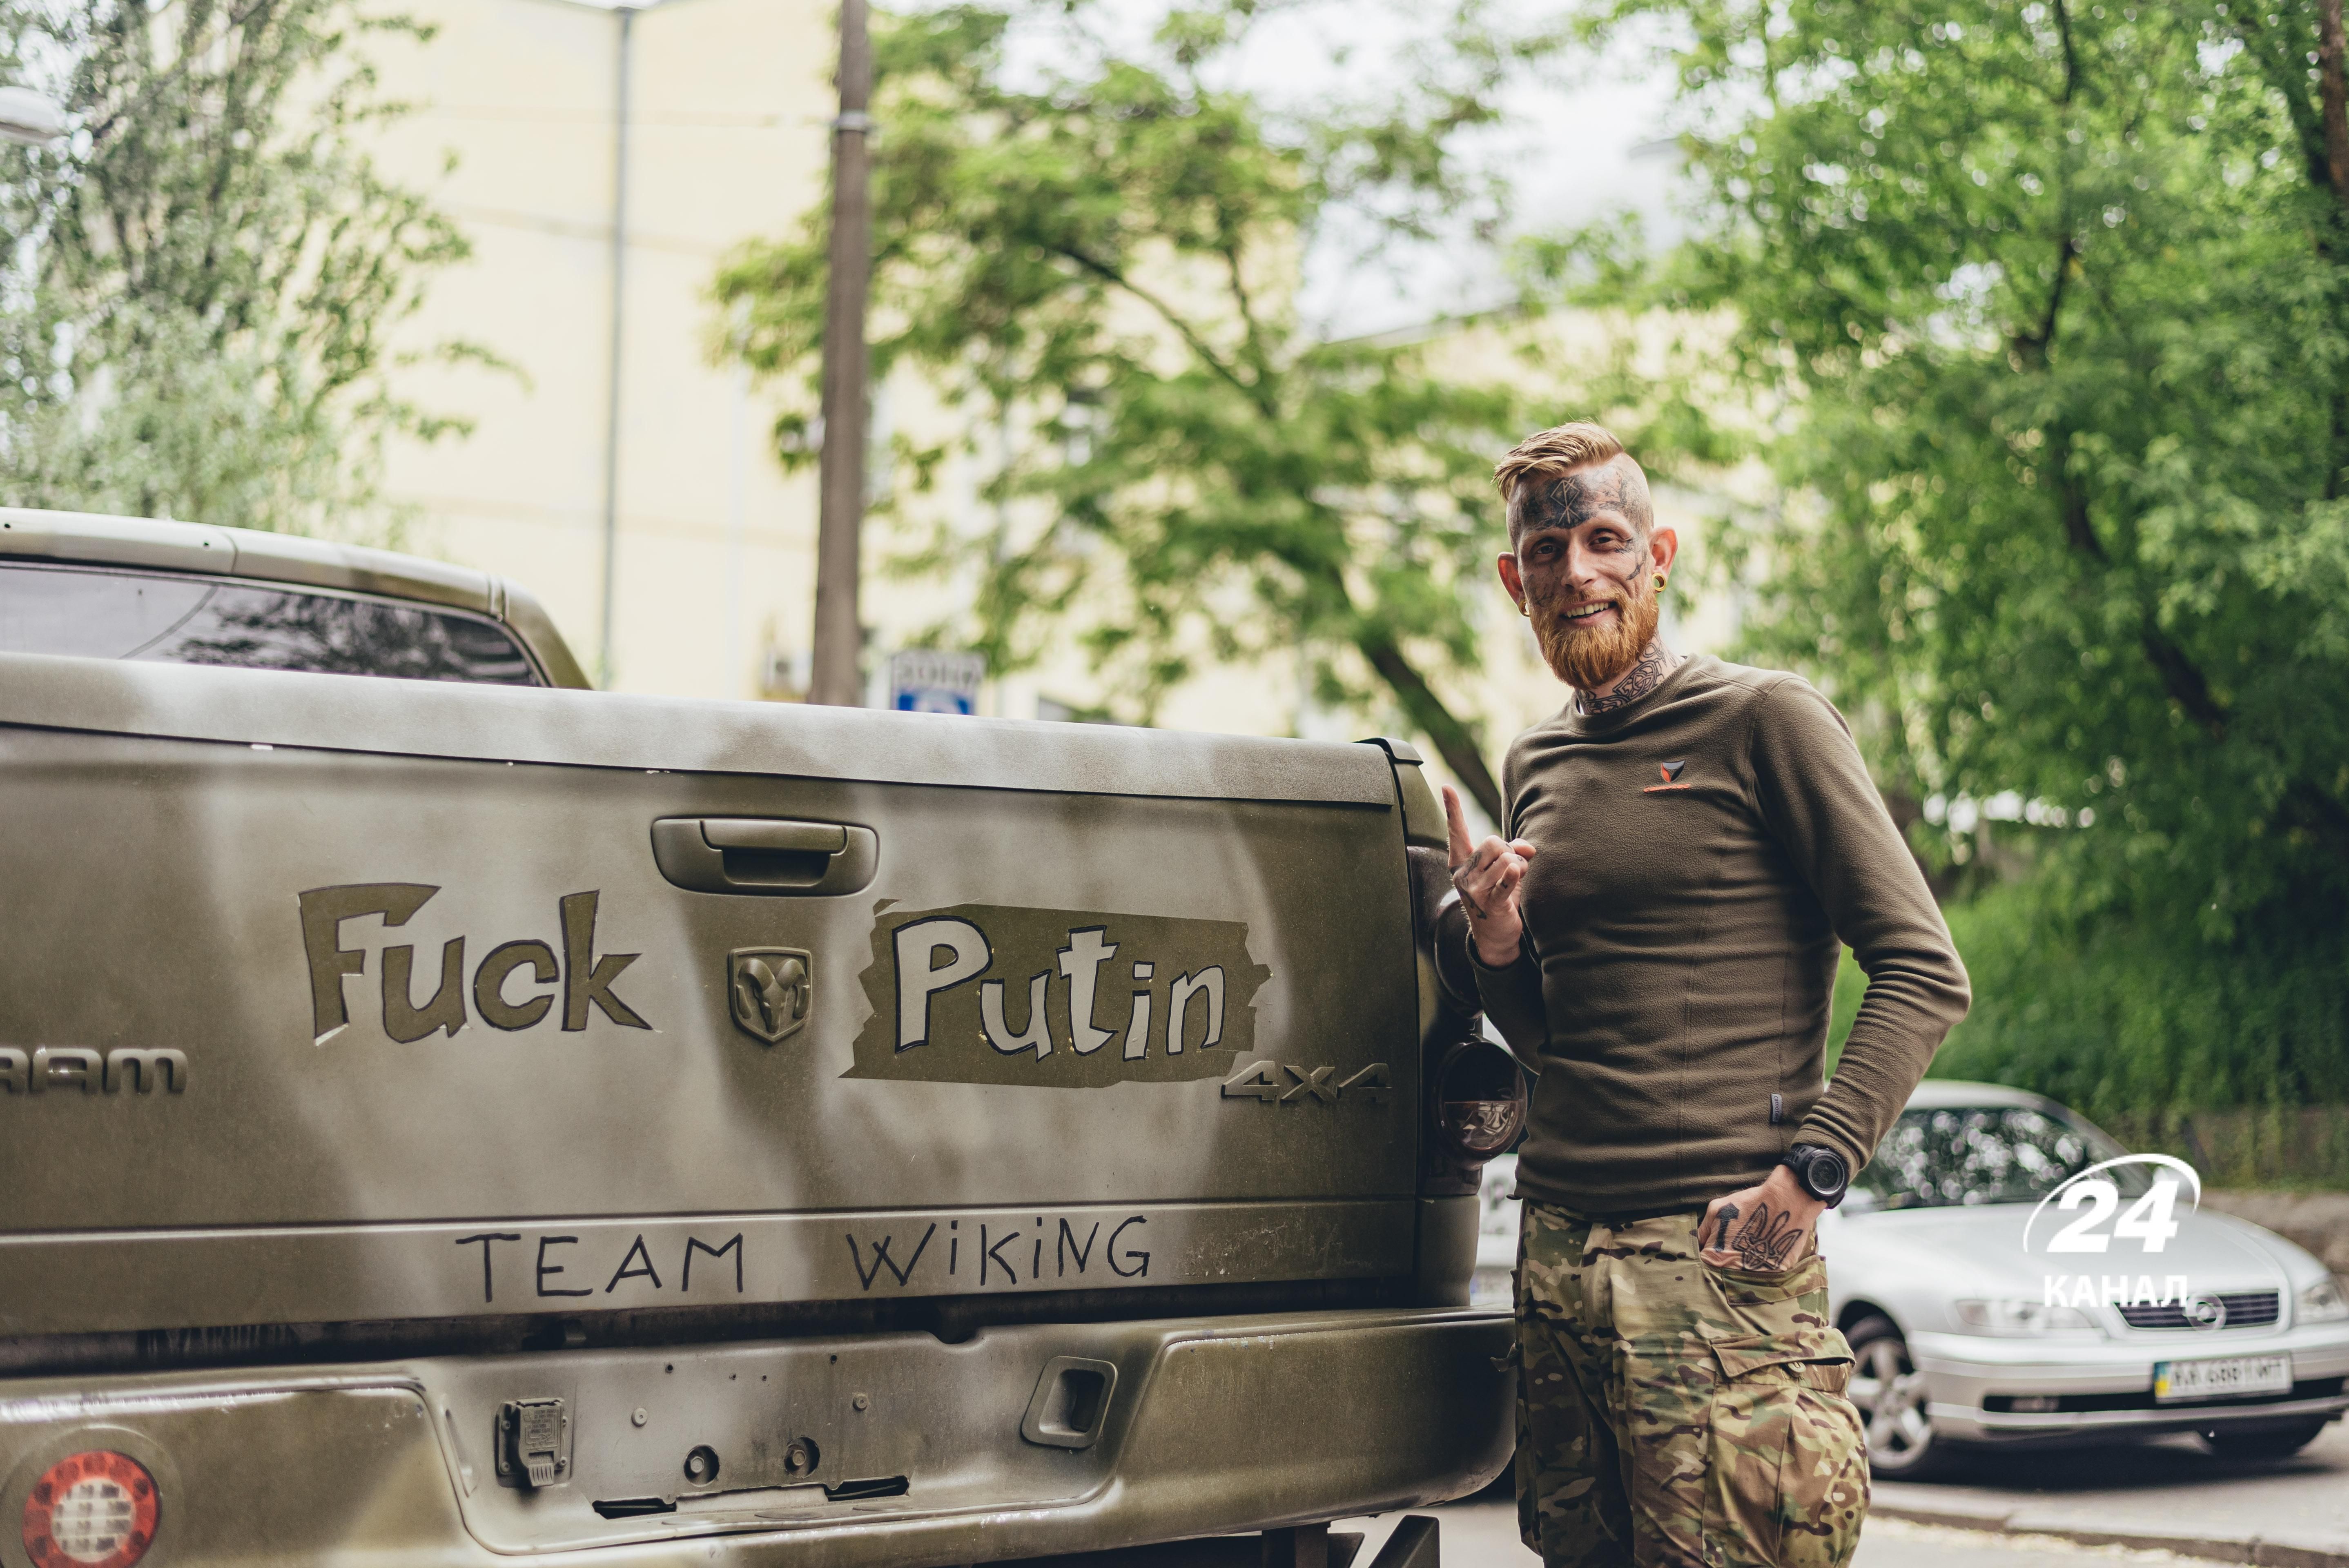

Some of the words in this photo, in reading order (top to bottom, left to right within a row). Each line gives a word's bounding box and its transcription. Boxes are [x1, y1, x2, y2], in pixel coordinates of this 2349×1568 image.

[298, 882, 654, 1045] Fuck
[893, 915, 1227, 1062] Putin
[456, 1233, 744, 1303] TEAM
